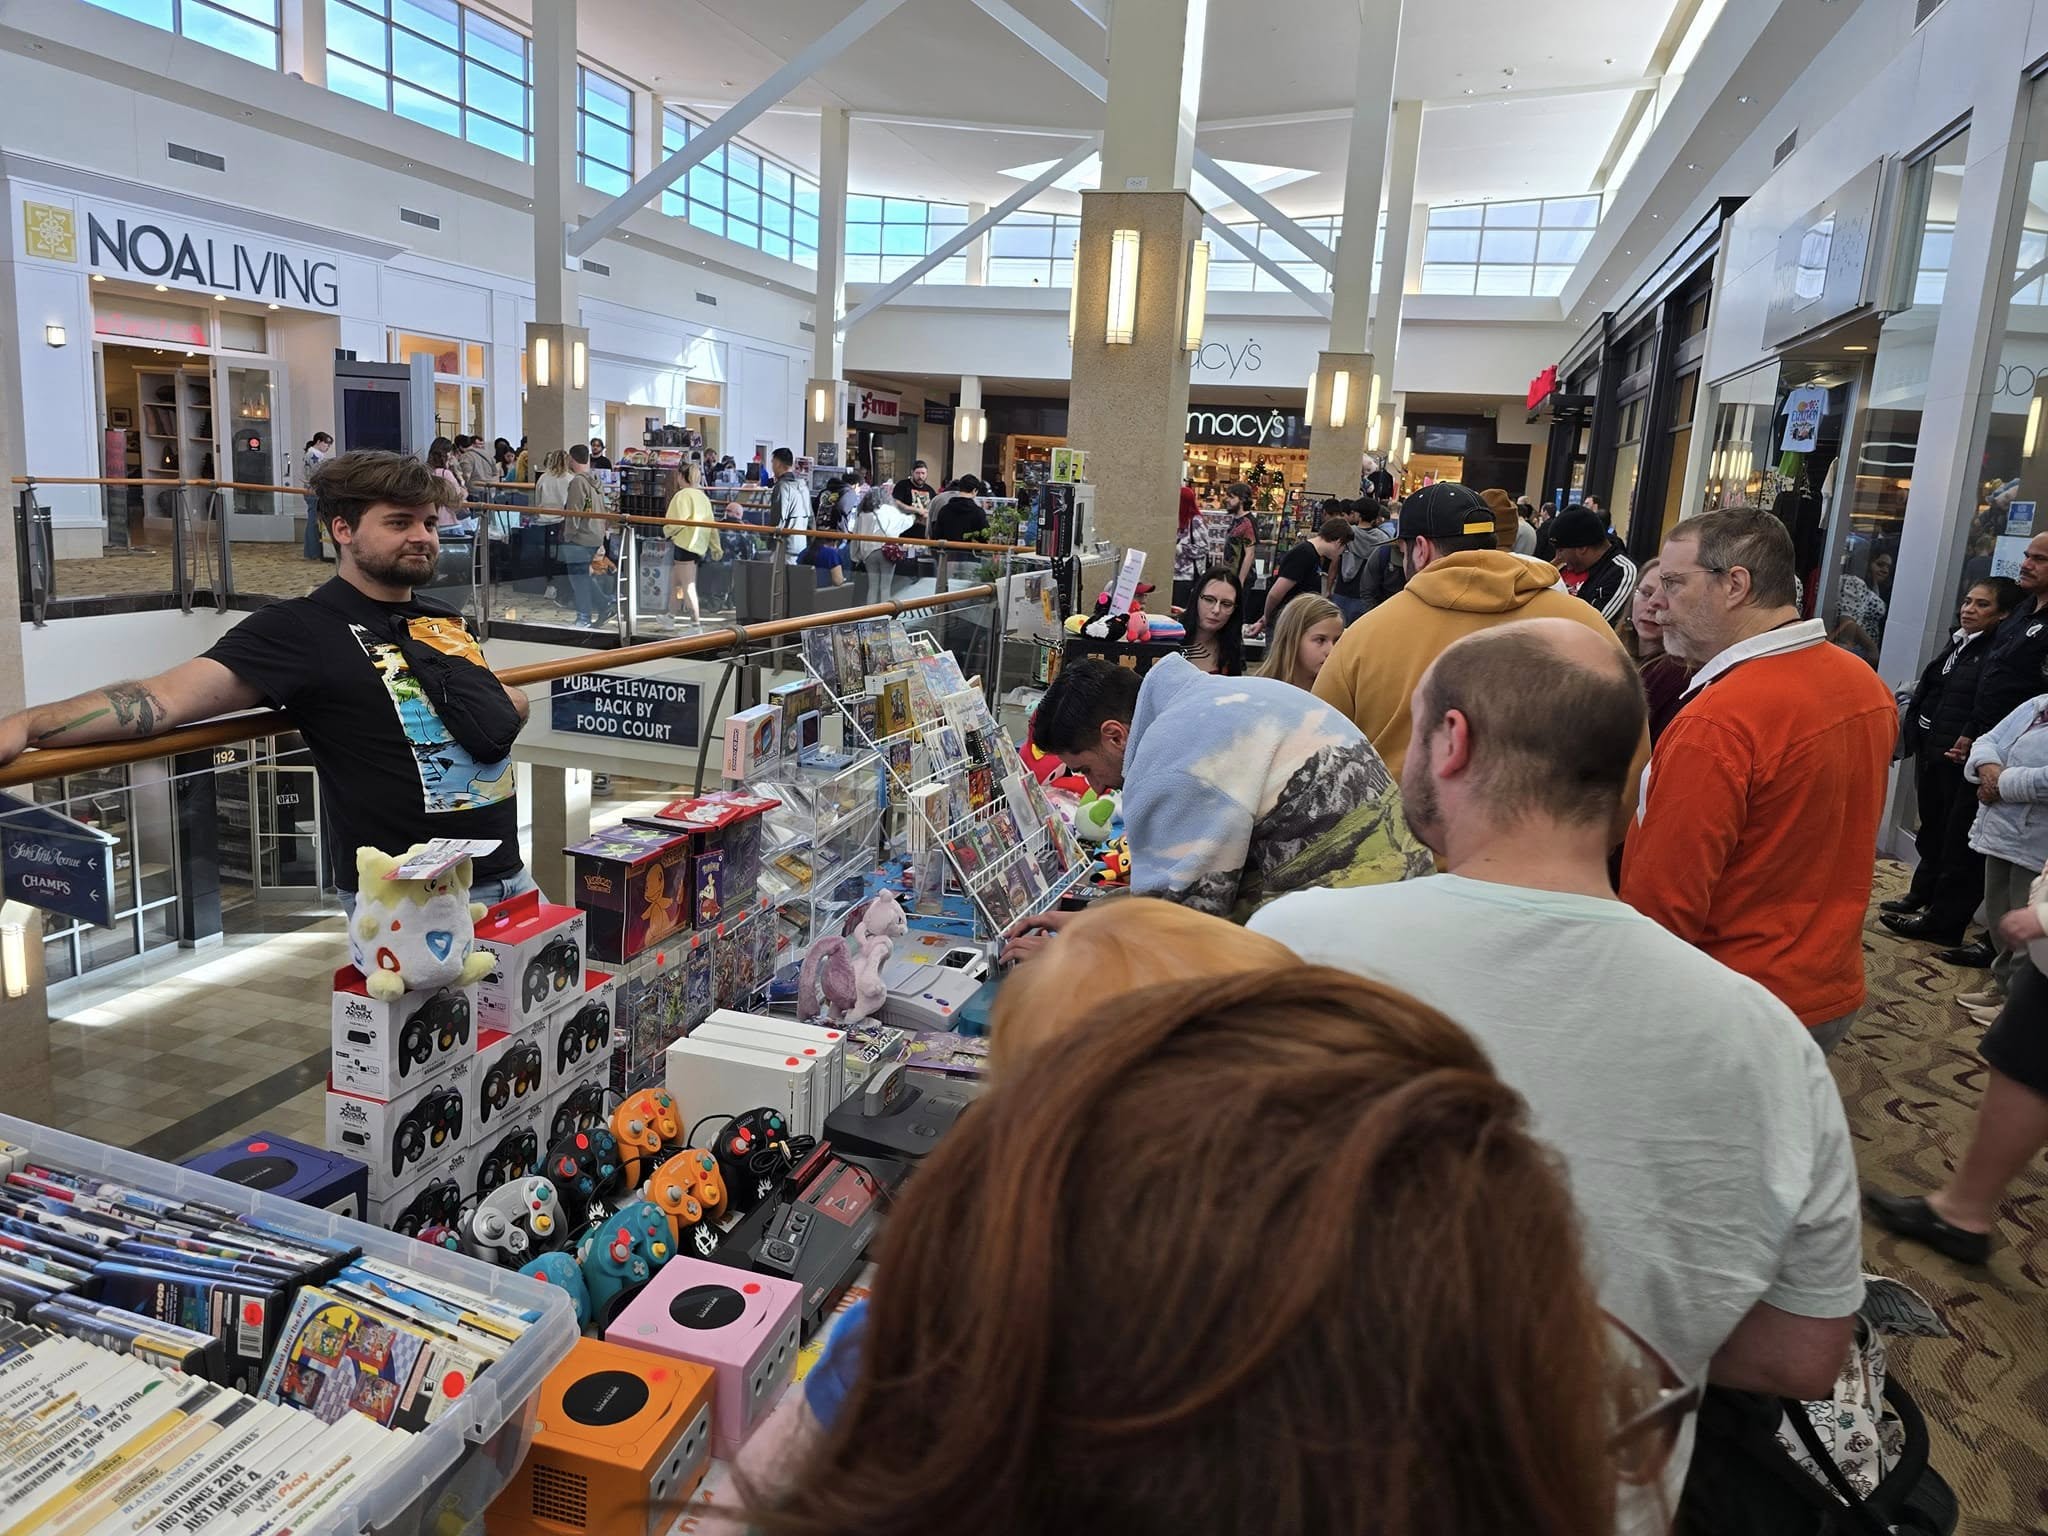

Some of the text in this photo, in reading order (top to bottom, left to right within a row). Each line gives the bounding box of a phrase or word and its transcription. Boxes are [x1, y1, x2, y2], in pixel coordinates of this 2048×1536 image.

[1186, 408, 1285, 444] macy's
[563, 675, 686, 702] PUBLIC ELEVATOR
[595, 697, 654, 718] BACK BY
[577, 715, 672, 740] FOOD COURT
[278, 794, 299, 804] OPEN
[22, 874, 71, 895] CHAMPS
[12, 1391, 38, 1410] Battle
[40, 1360, 88, 1392] Revolution
[108, 1413, 132, 1430] 2010
[162, 1472, 206, 1506] OUTDOOR
[204, 1432, 258, 1472] ADVENTURES
[156, 1463, 246, 1532] JUST DANCE 2014
[184, 1469, 262, 1530] JUST DANCE 4
[232, 1468, 290, 1516] JUST DANCE 2
